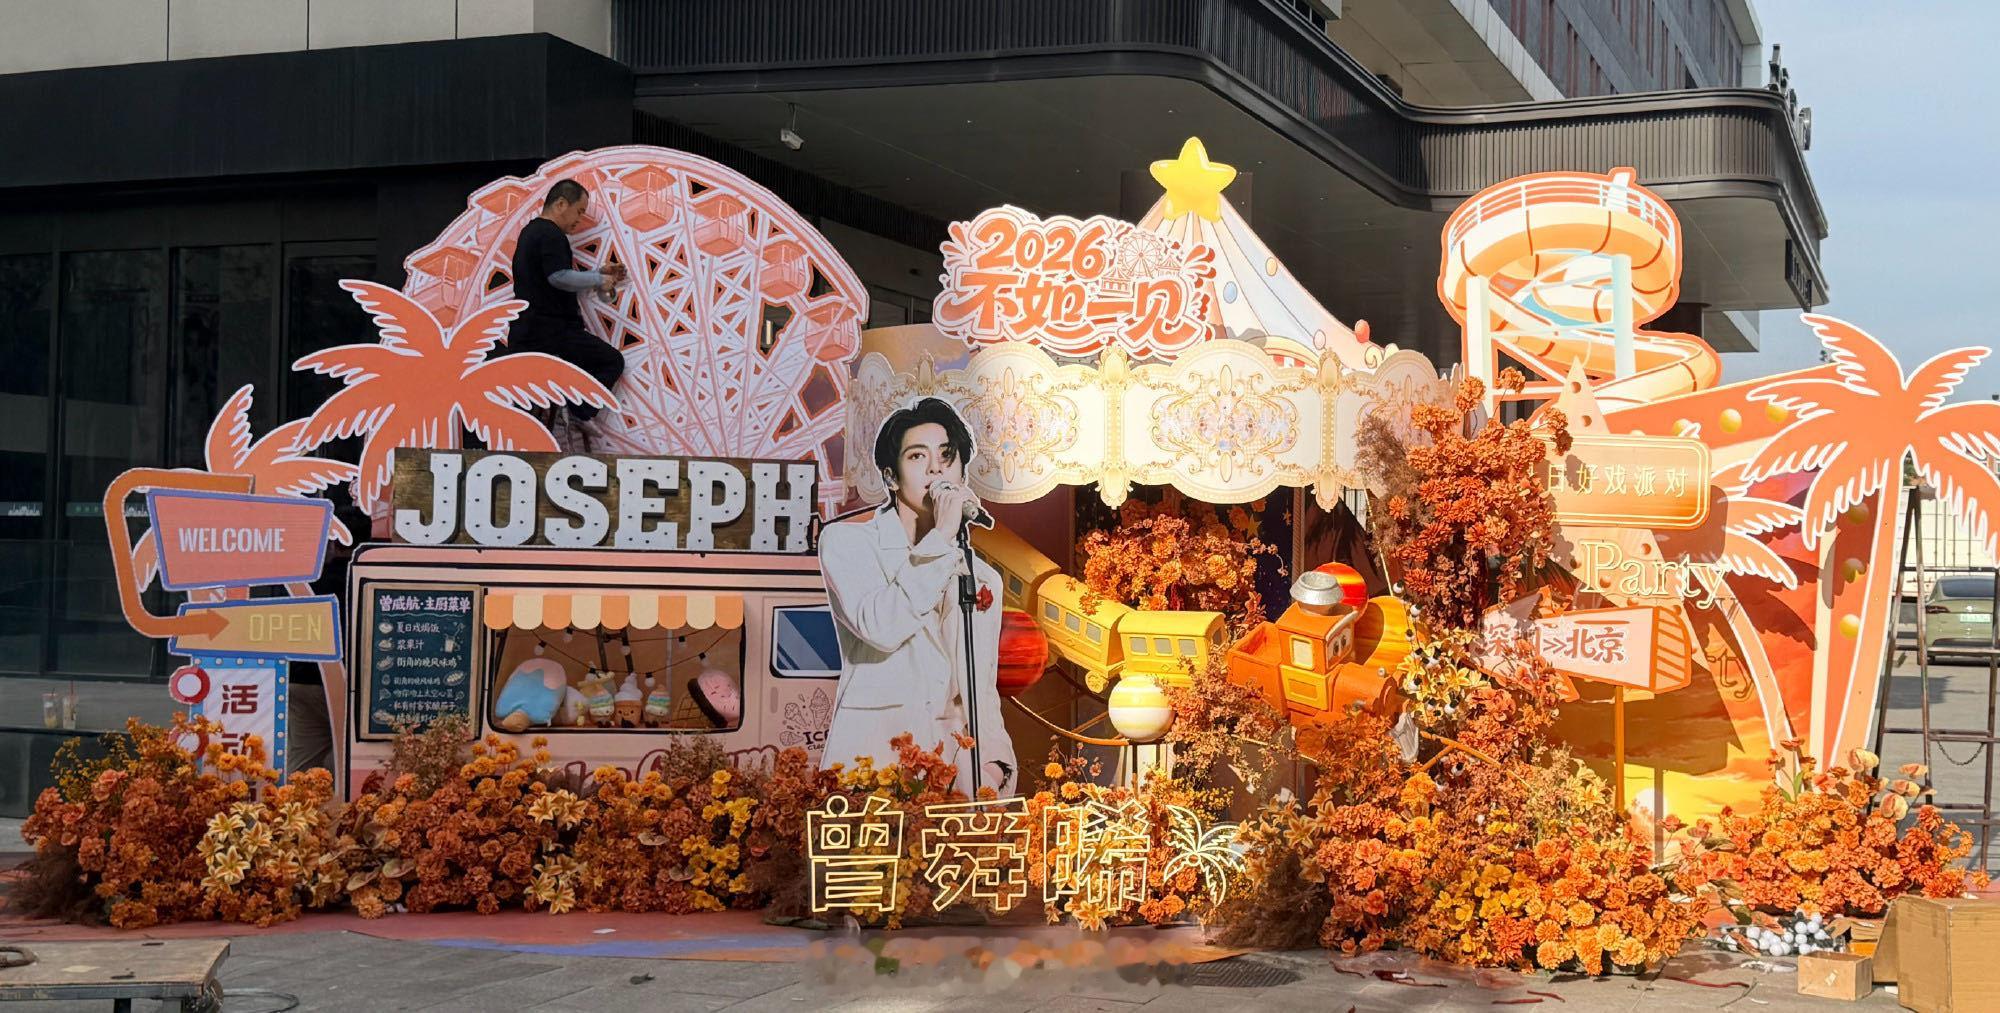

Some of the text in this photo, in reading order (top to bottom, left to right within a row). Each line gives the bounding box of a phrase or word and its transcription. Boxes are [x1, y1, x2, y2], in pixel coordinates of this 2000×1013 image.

[976, 218, 1107, 279] 2026
[940, 271, 1199, 345] 不如一见
[394, 452, 817, 551] JOSEPH
[1527, 462, 1690, 498] 日好戏派对
[178, 527, 286, 553] WELCOME
[1579, 540, 1728, 609] Party
[249, 613, 322, 642] OPEN
[806, 795, 1151, 912] 曾舜晞
